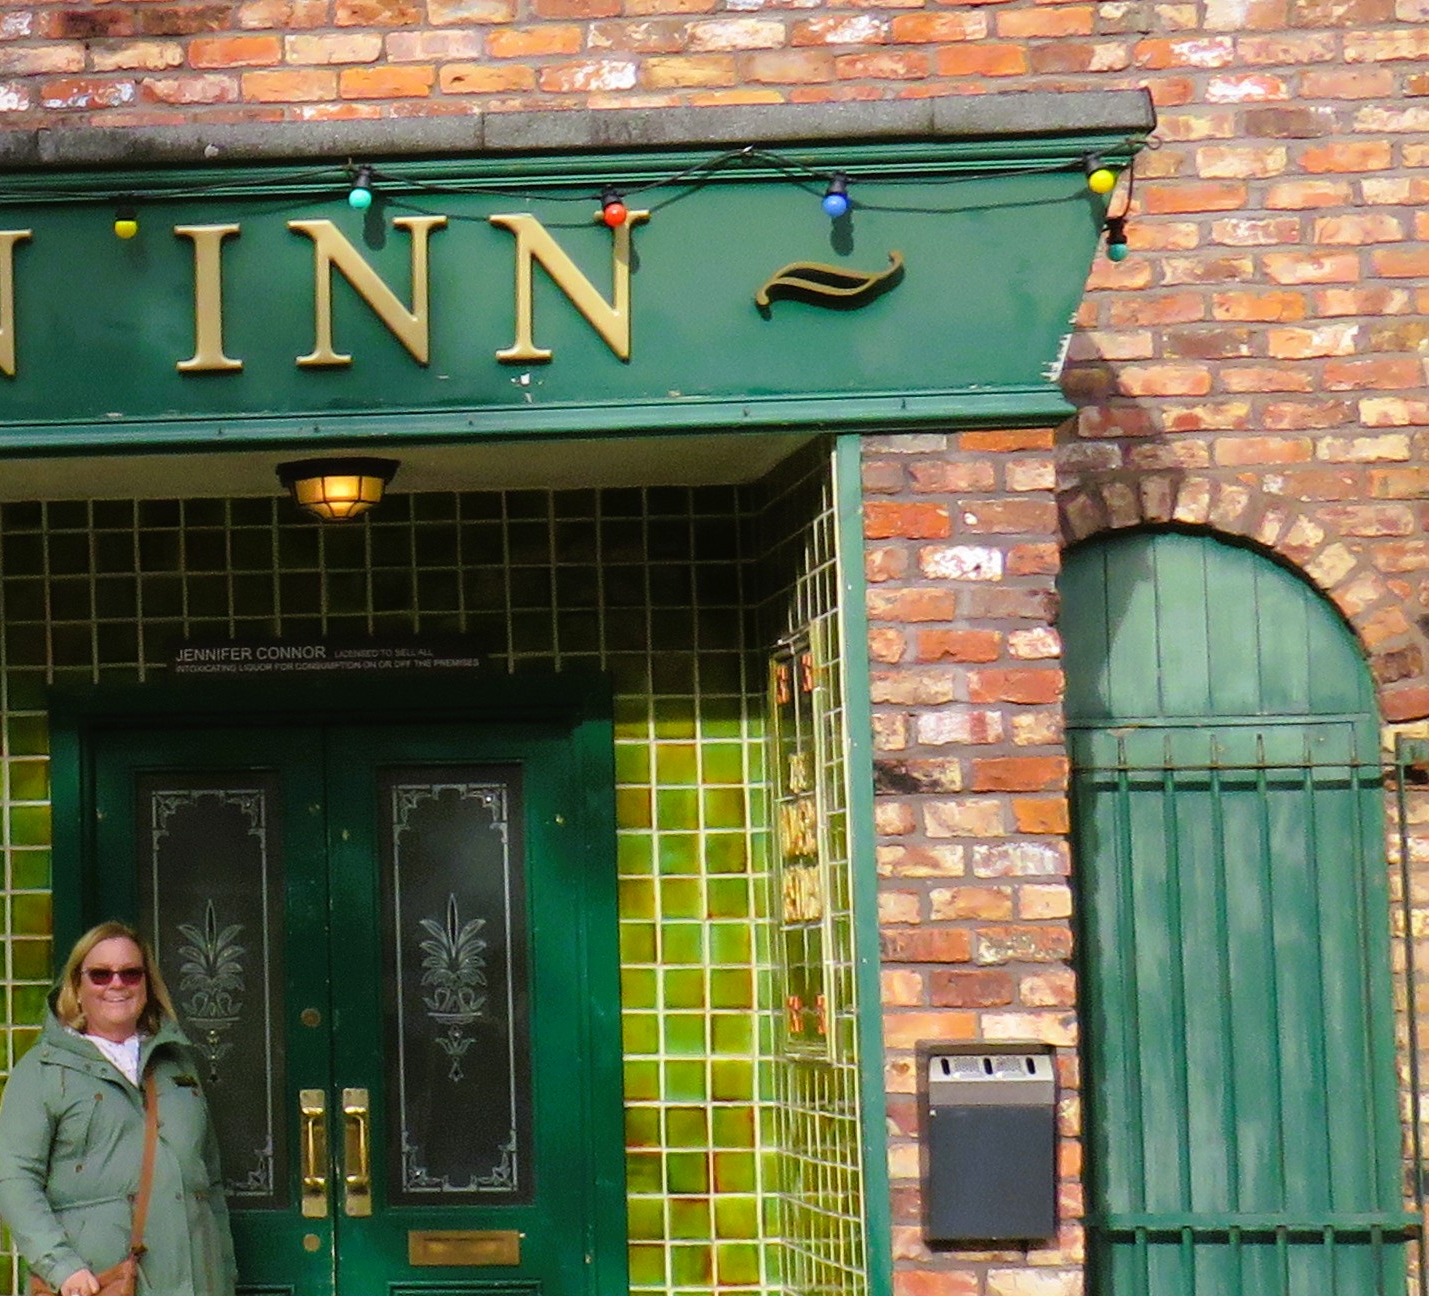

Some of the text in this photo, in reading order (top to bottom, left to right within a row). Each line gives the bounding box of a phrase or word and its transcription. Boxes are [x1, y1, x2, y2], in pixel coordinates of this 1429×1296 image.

[174, 209, 650, 372] INN
[175, 648, 252, 662] JENNIFER
[256, 645, 327, 660] CONNOR
